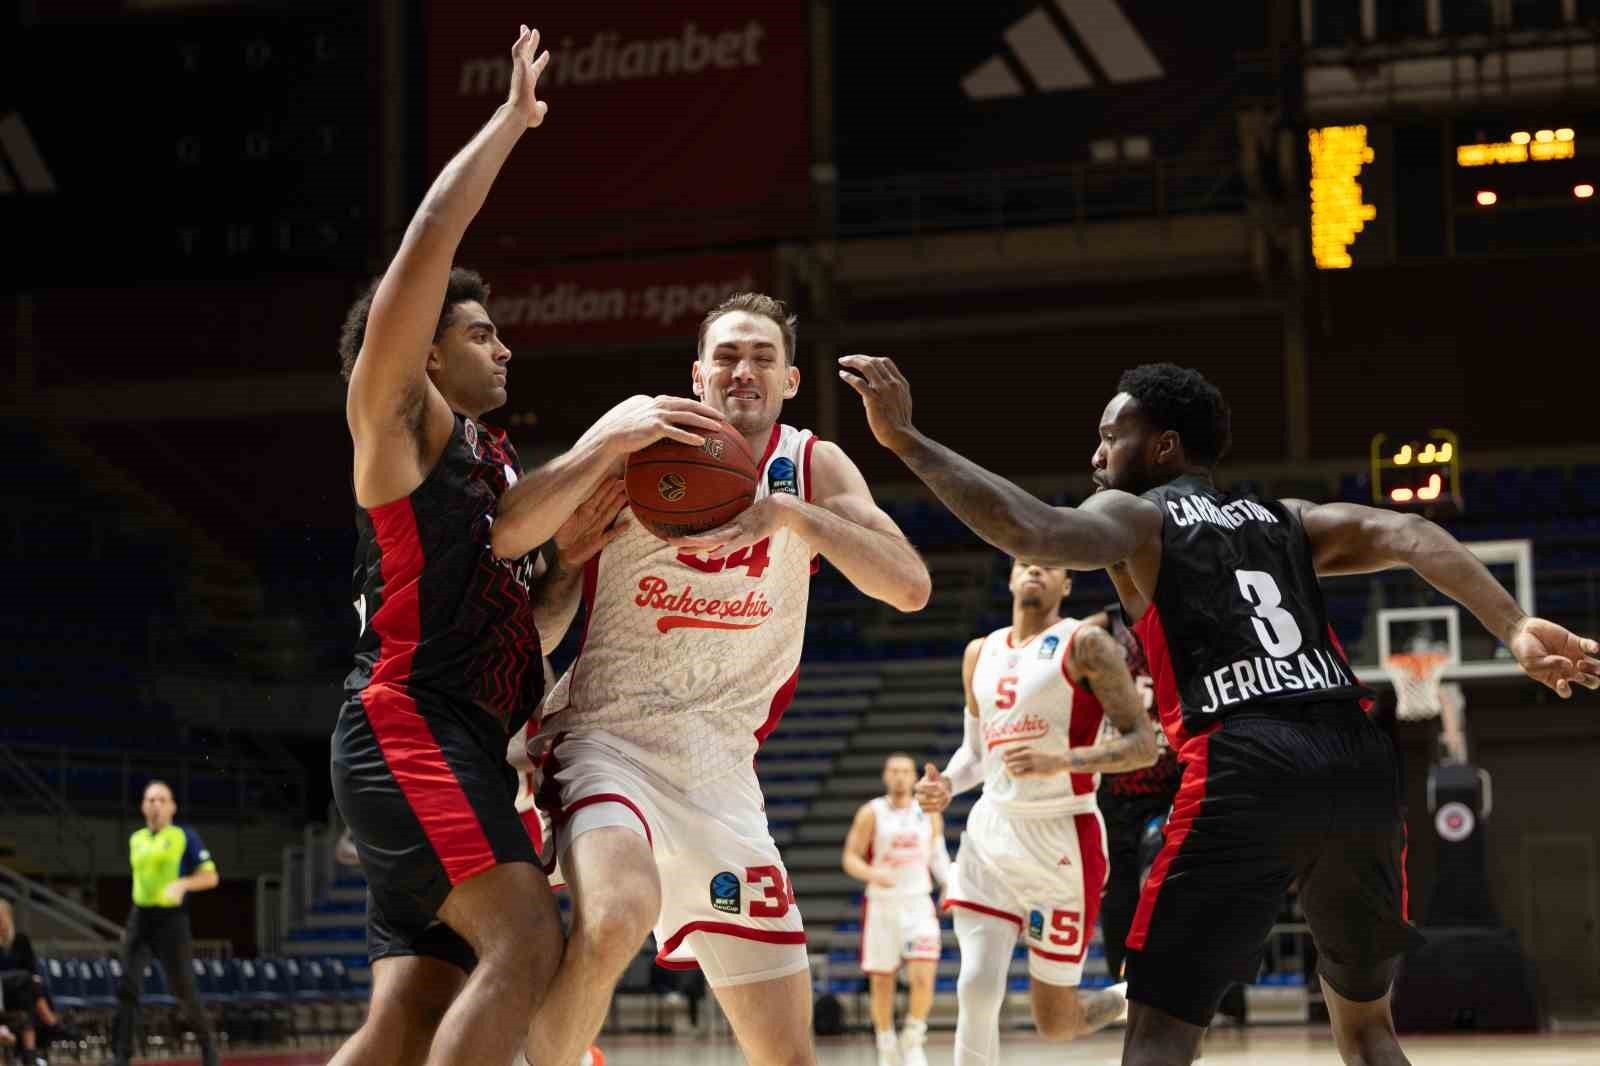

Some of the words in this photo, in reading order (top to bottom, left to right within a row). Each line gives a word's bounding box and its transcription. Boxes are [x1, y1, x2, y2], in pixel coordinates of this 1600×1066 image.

[1235, 569, 1302, 659] 3
[995, 675, 1018, 710] 5
[1202, 648, 1352, 713] JERUSAL
[745, 864, 796, 918] 3
[1049, 909, 1080, 946] 5
